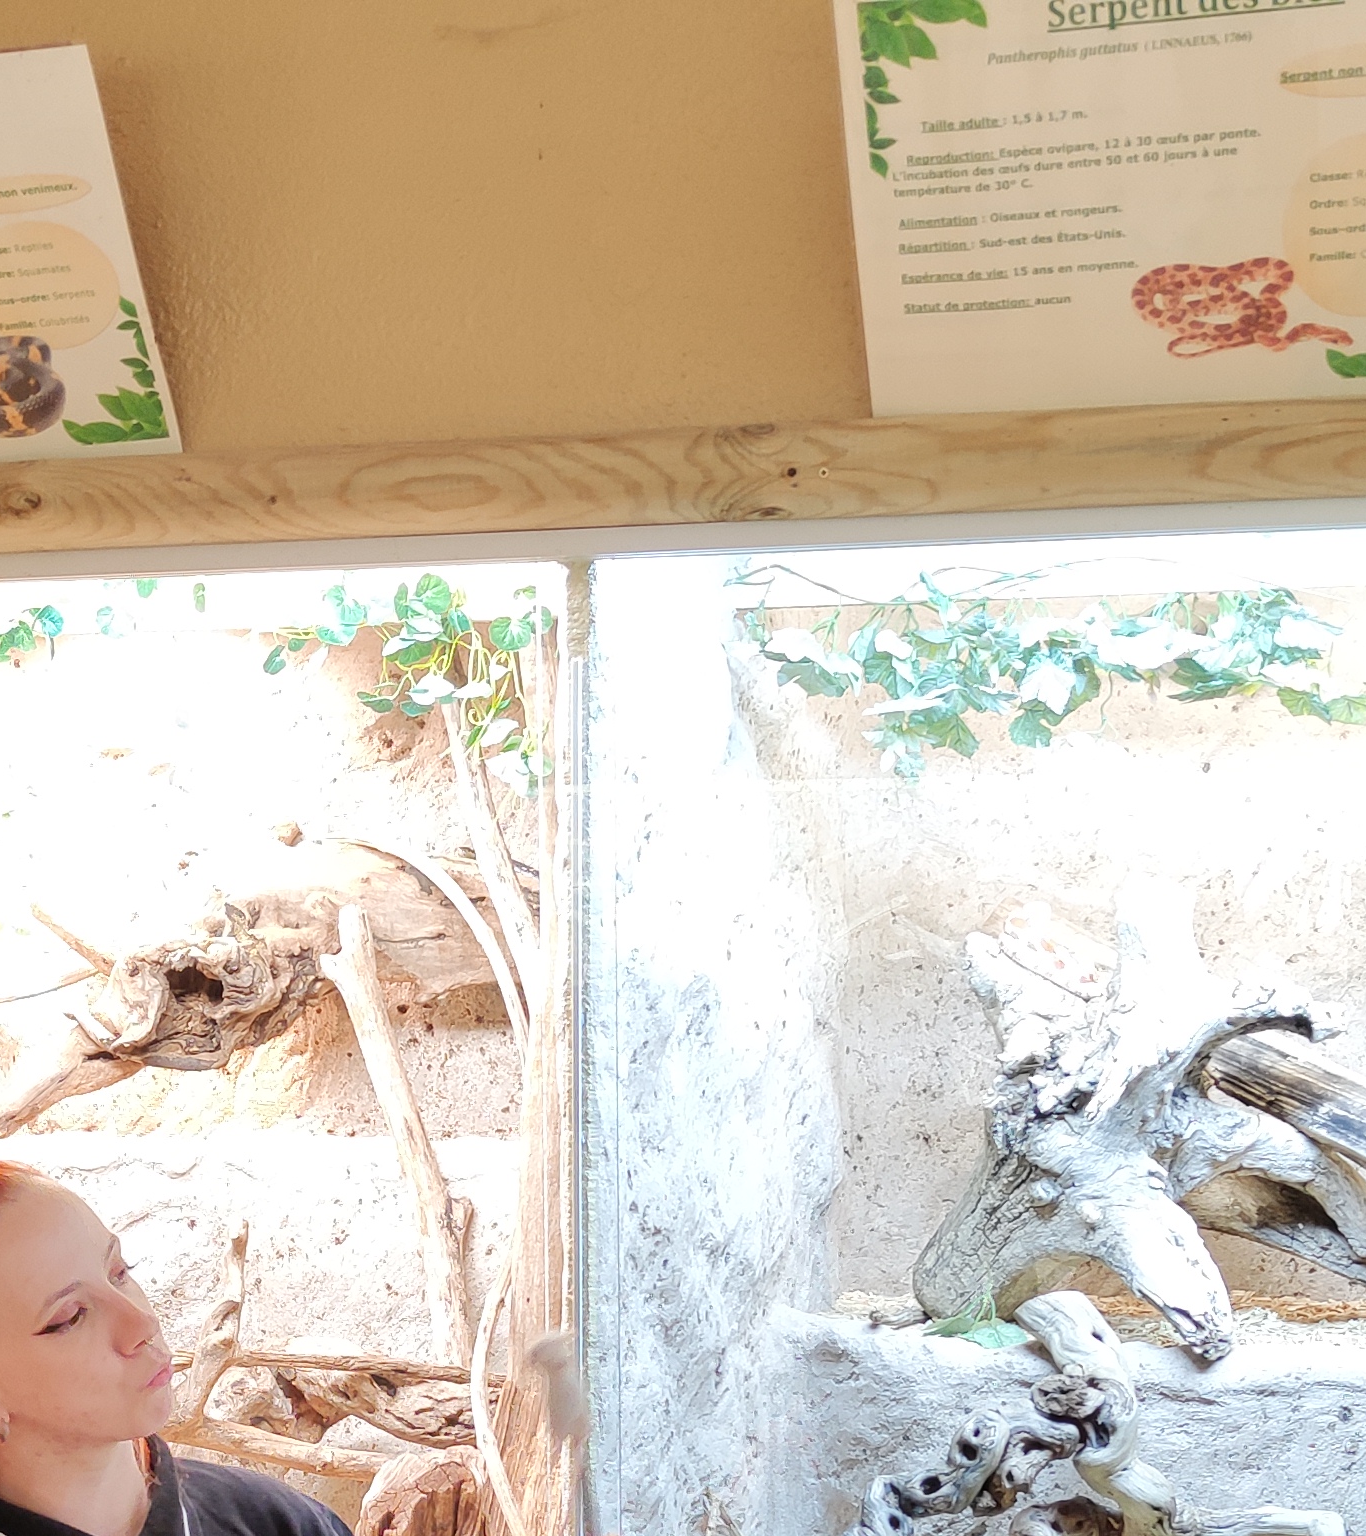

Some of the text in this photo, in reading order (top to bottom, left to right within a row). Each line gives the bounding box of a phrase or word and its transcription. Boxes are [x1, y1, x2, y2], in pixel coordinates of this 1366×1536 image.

[987, 44, 1077, 66] Pantherophis
[1079, 40, 1138, 61] guttatus
[1280, 68, 1333, 84] Serpent
[1337, 65, 1363, 77] non
[921, 120, 955, 133] Taille
[958, 116, 999, 130] adulte
[1046, 141, 1100, 156] ovipare,
[1104, 138, 1120, 150] 12
[1193, 130, 1215, 145] par
[1219, 127, 1261, 142] ponte.
[972, 164, 995, 177] des
[1034, 159, 1063, 172] dure
[1067, 156, 1102, 169] entre
[1105, 154, 1122, 166] 50
[1142, 151, 1160, 162] 60
[1163, 148, 1197, 163] jours
[1213, 145, 1238, 157] une
[1309, 171, 1353, 183] Classe:
[21, 183, 78, 196] venimeux.
[894, 182, 970, 199] température
[975, 181, 991, 192] de
[1309, 199, 1348, 210] Ordre:
[898, 215, 977, 230] Alimentation
[990, 210, 1040, 223] Oiseaux
[1060, 204, 1123, 219] rongeurs.
[898, 240, 967, 255] Répartition
[979, 236, 1028, 249] Sud-est
[1031, 234, 1053, 245] des
[1309, 251, 1356, 262] Famille:
[901, 271, 964, 285] Espérance
[1077, 260, 1139, 275] moyenne.
[903, 302, 942, 315] Statut
